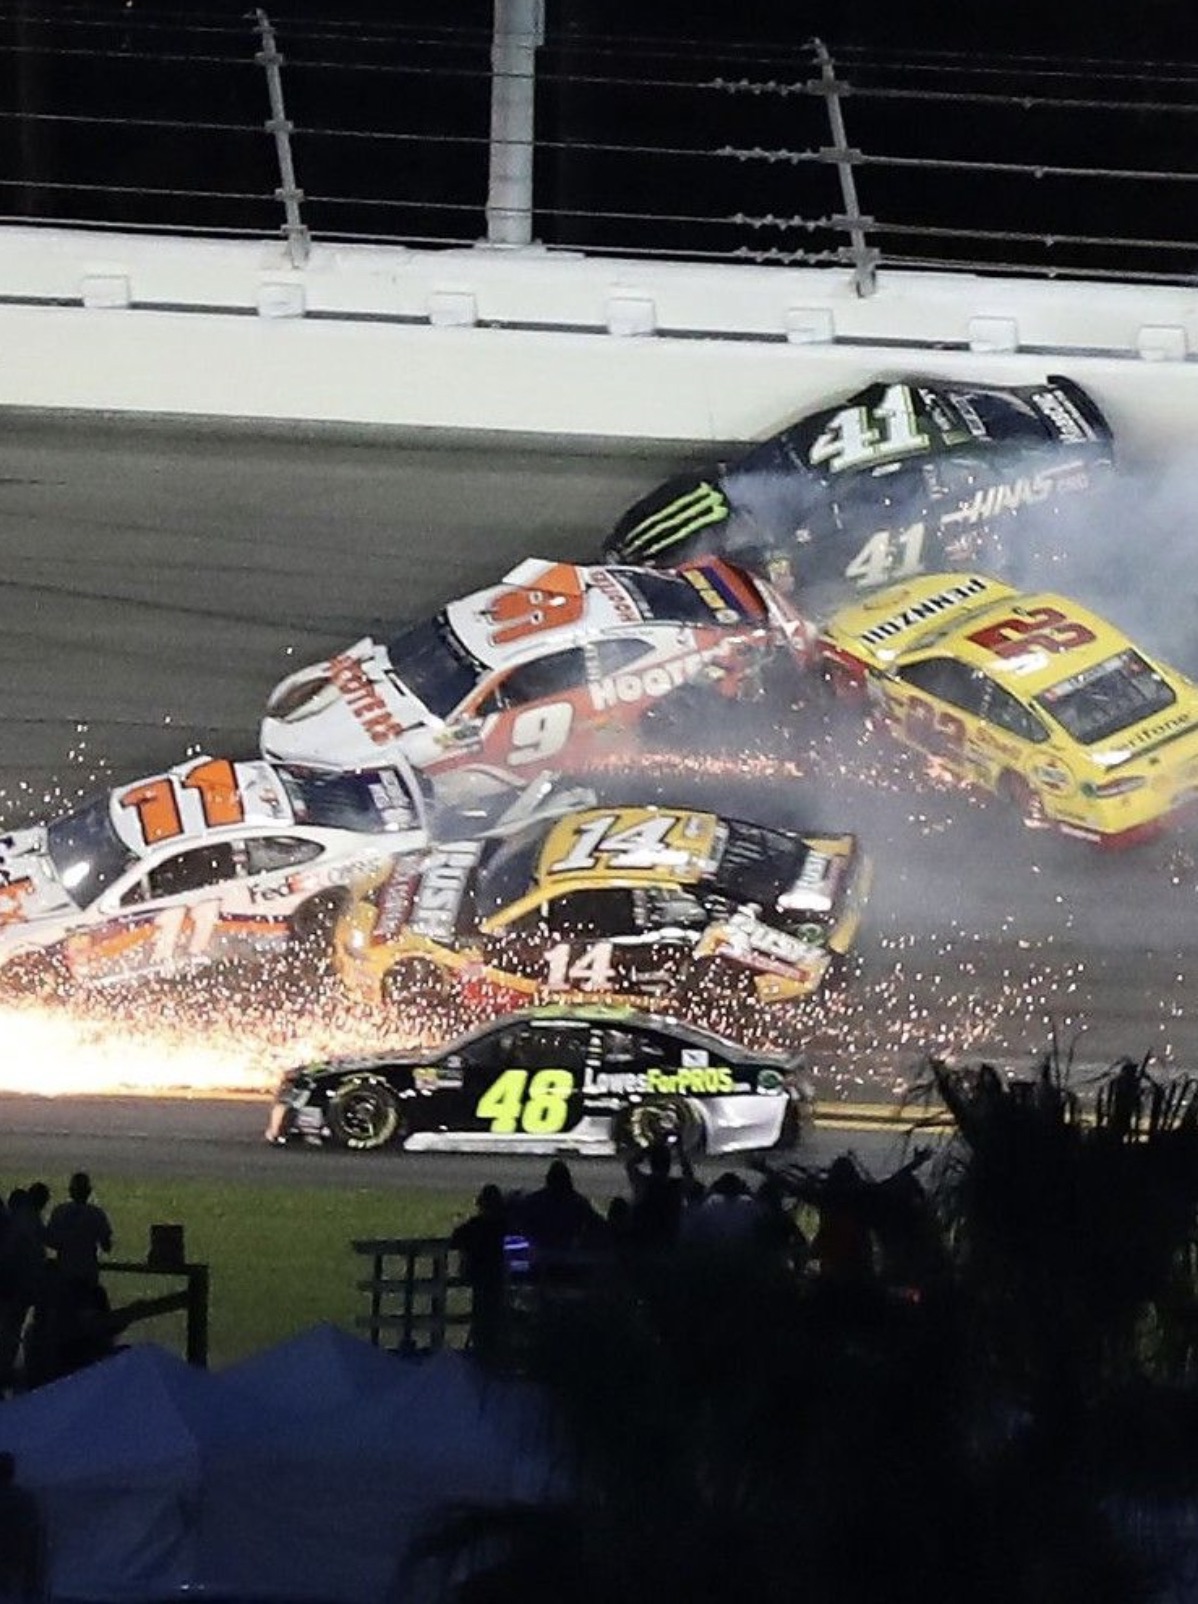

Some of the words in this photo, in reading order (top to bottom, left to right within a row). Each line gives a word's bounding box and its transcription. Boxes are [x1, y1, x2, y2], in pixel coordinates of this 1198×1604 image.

[810, 384, 930, 473] 41
[845, 522, 927, 587] 41
[506, 702, 574, 766] 9
[122, 758, 245, 846] 11
[550, 813, 690, 872] 14
[540, 942, 616, 991] 14
[475, 1068, 575, 1134] 48
